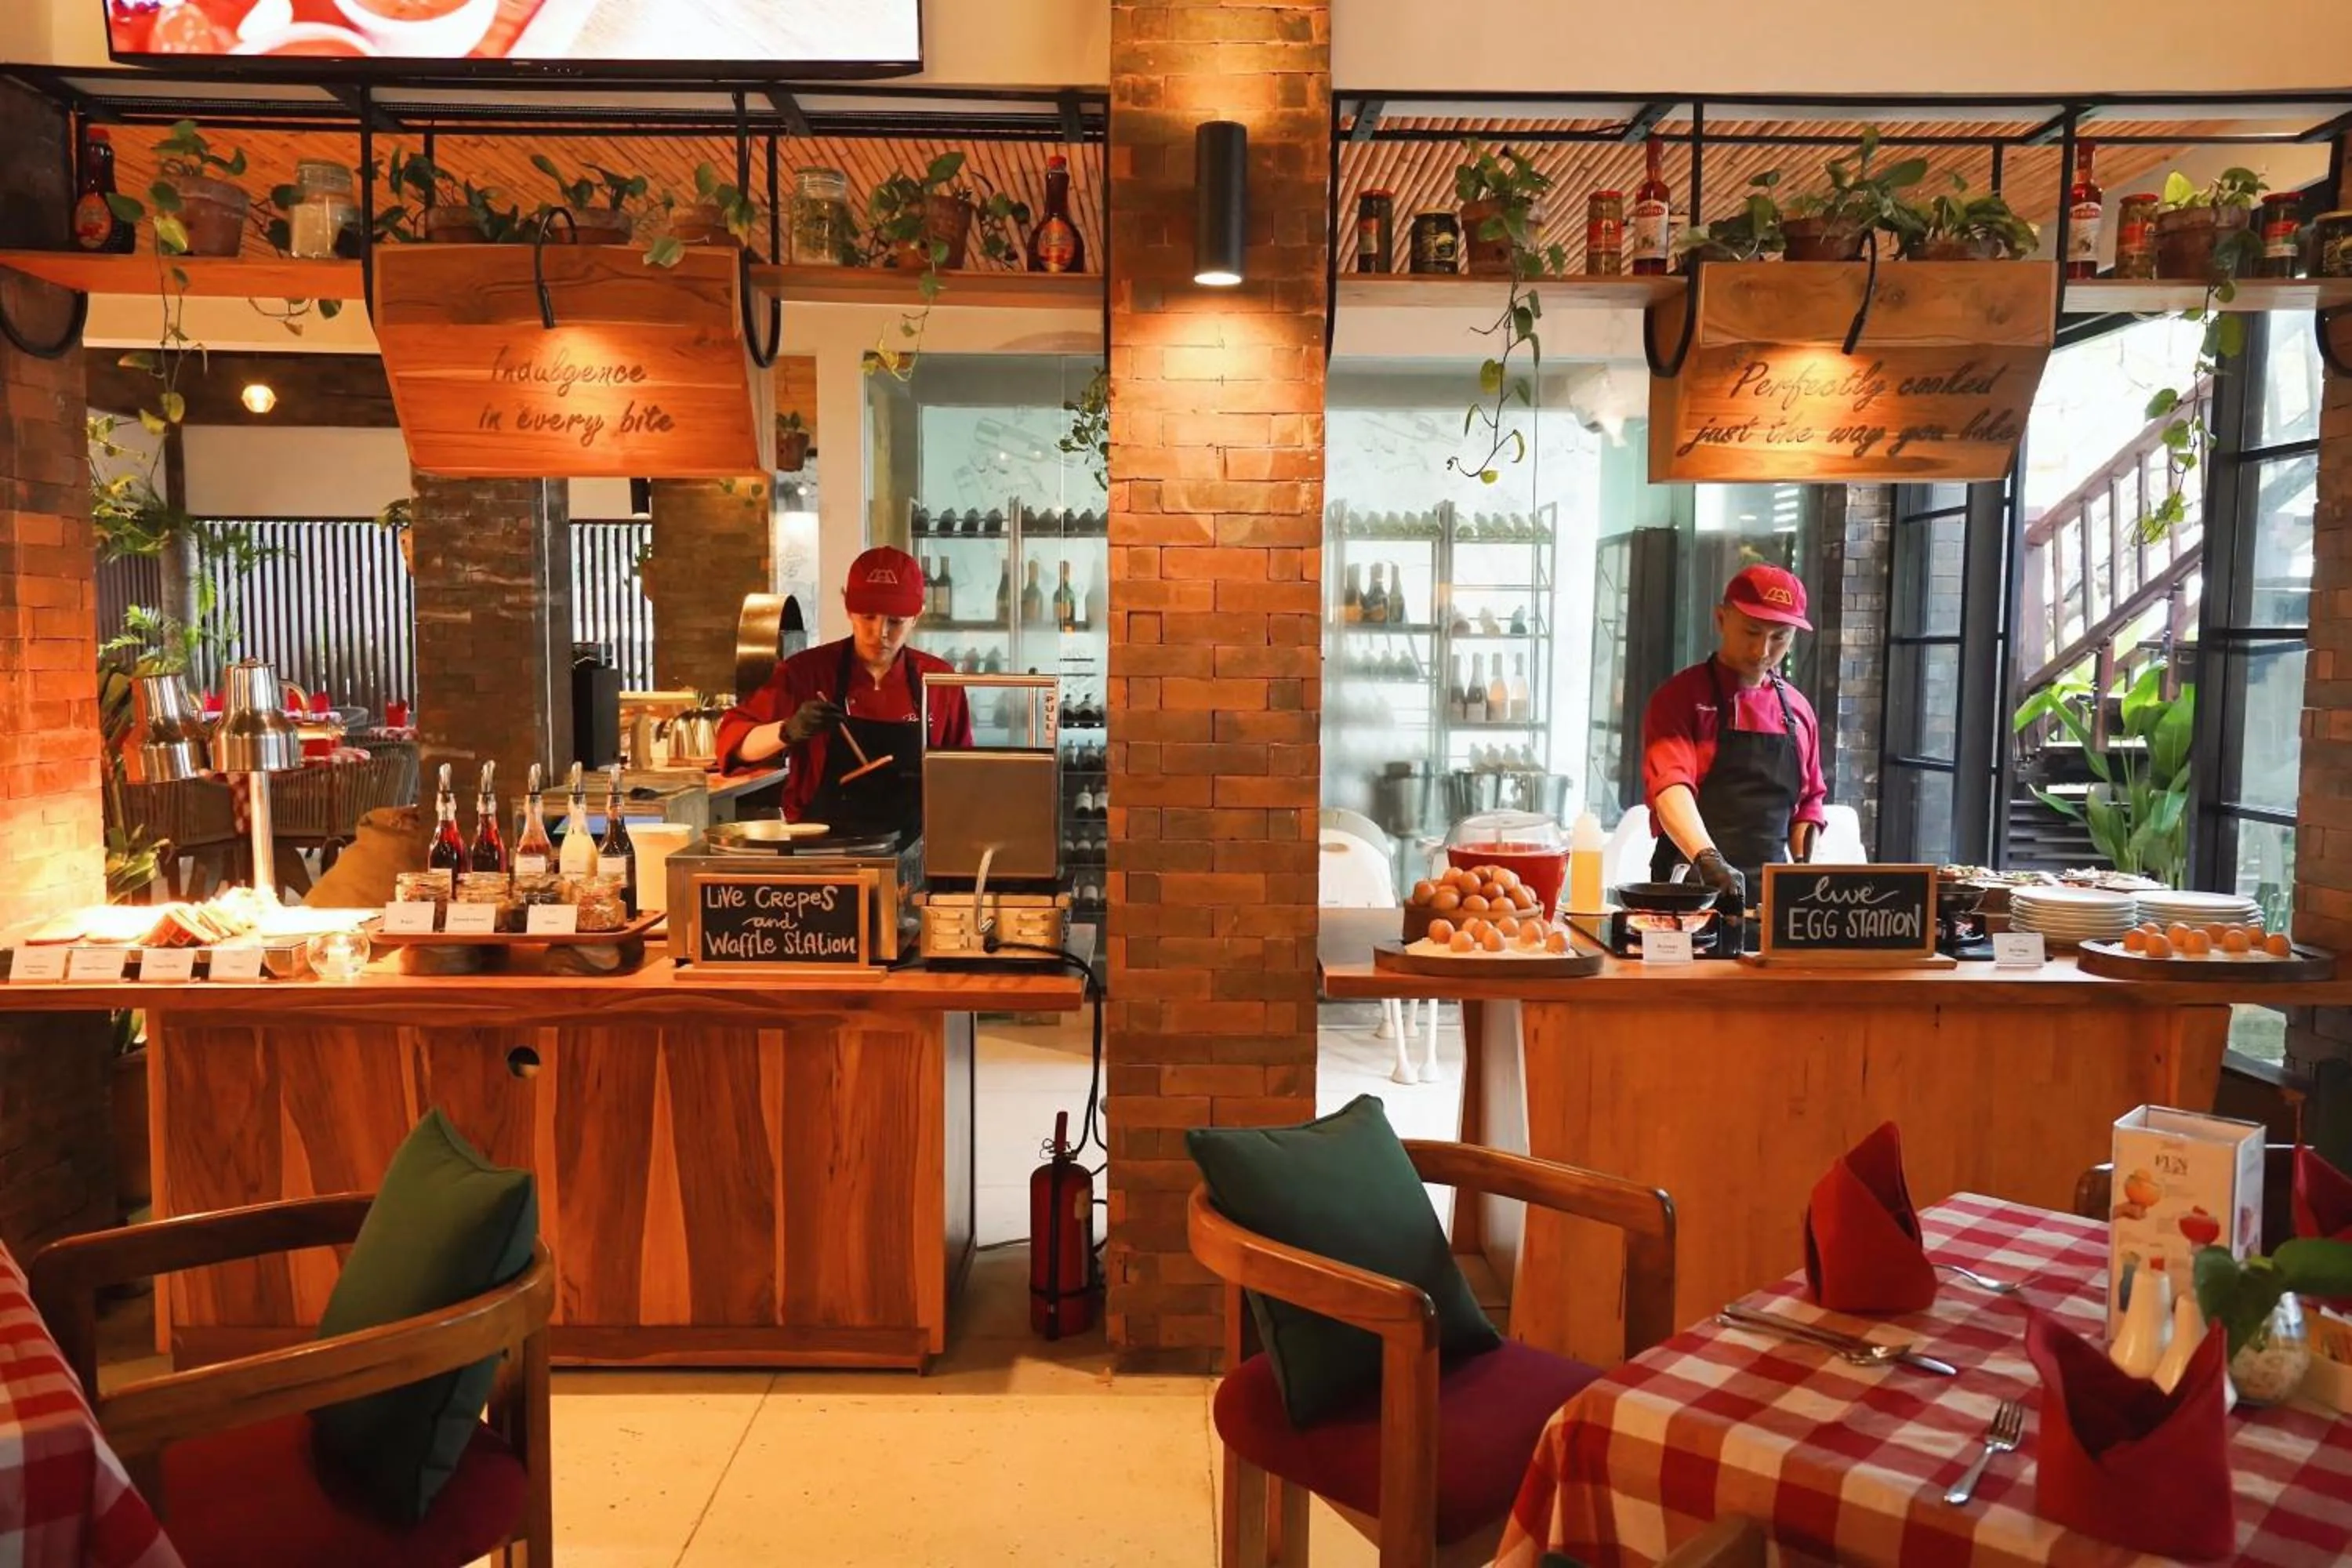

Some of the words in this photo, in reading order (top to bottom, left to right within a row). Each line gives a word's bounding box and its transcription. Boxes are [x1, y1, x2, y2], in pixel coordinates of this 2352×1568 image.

[490, 345, 648, 397] Indulgence
[1729, 360, 1887, 412] Perfectly
[1896, 361, 2009, 397] cooked
[478, 403, 502, 432] in
[516, 408, 606, 448] every
[619, 400, 677, 434] bite
[1675, 416, 1760, 458] just
[1766, 412, 1814, 444] the
[1825, 425, 1887, 458] way
[1887, 423, 1948, 457] you
[1045, 695, 1054, 731] PULL
[741, 913, 798, 930] and
[1788, 907, 1839, 940] EGG
